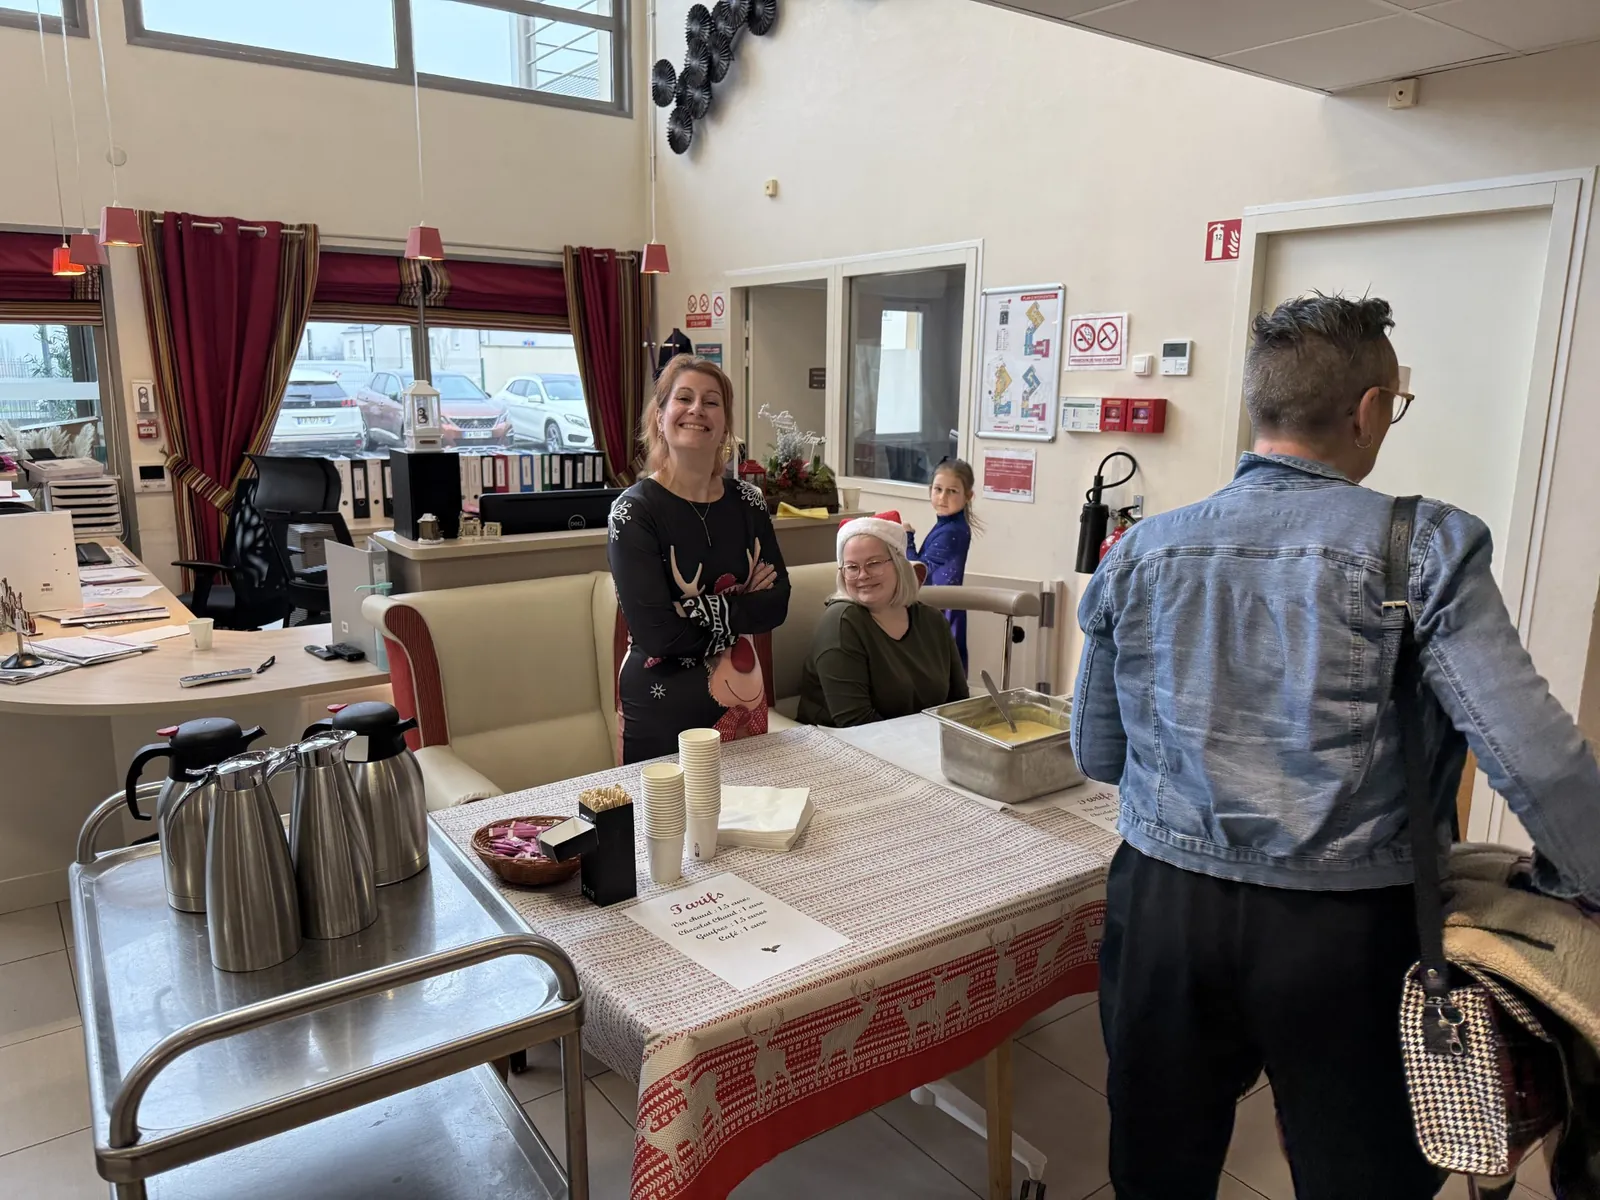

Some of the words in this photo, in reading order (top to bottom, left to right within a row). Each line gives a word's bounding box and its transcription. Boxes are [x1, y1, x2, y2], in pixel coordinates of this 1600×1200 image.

[670, 892, 724, 915] Tarifs
[678, 921, 712, 936] Chocolat
[712, 910, 738, 923] Chaud
[689, 910, 713, 922] chaud
[696, 925, 728, 940] Gaufres
[718, 930, 739, 941] Café
